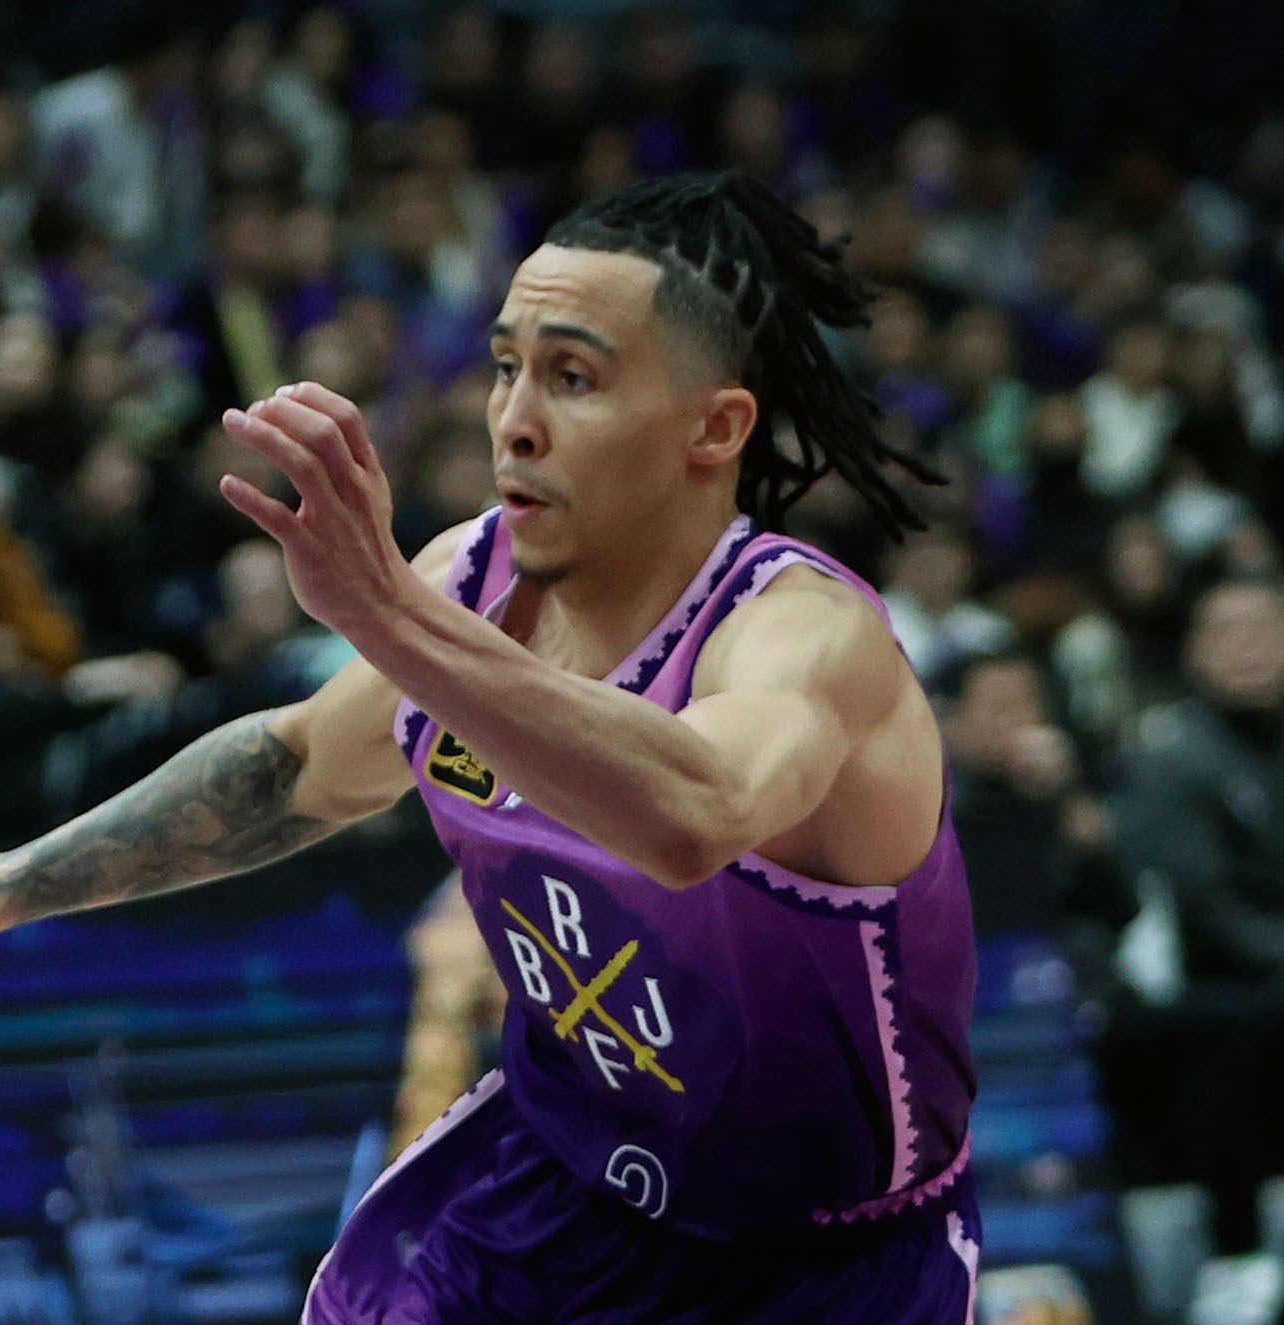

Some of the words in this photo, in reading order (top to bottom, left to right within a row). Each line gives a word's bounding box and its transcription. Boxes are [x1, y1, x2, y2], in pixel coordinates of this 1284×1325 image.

[541, 874, 591, 958] R
[504, 927, 552, 1004] B
[633, 976, 673, 1048] J
